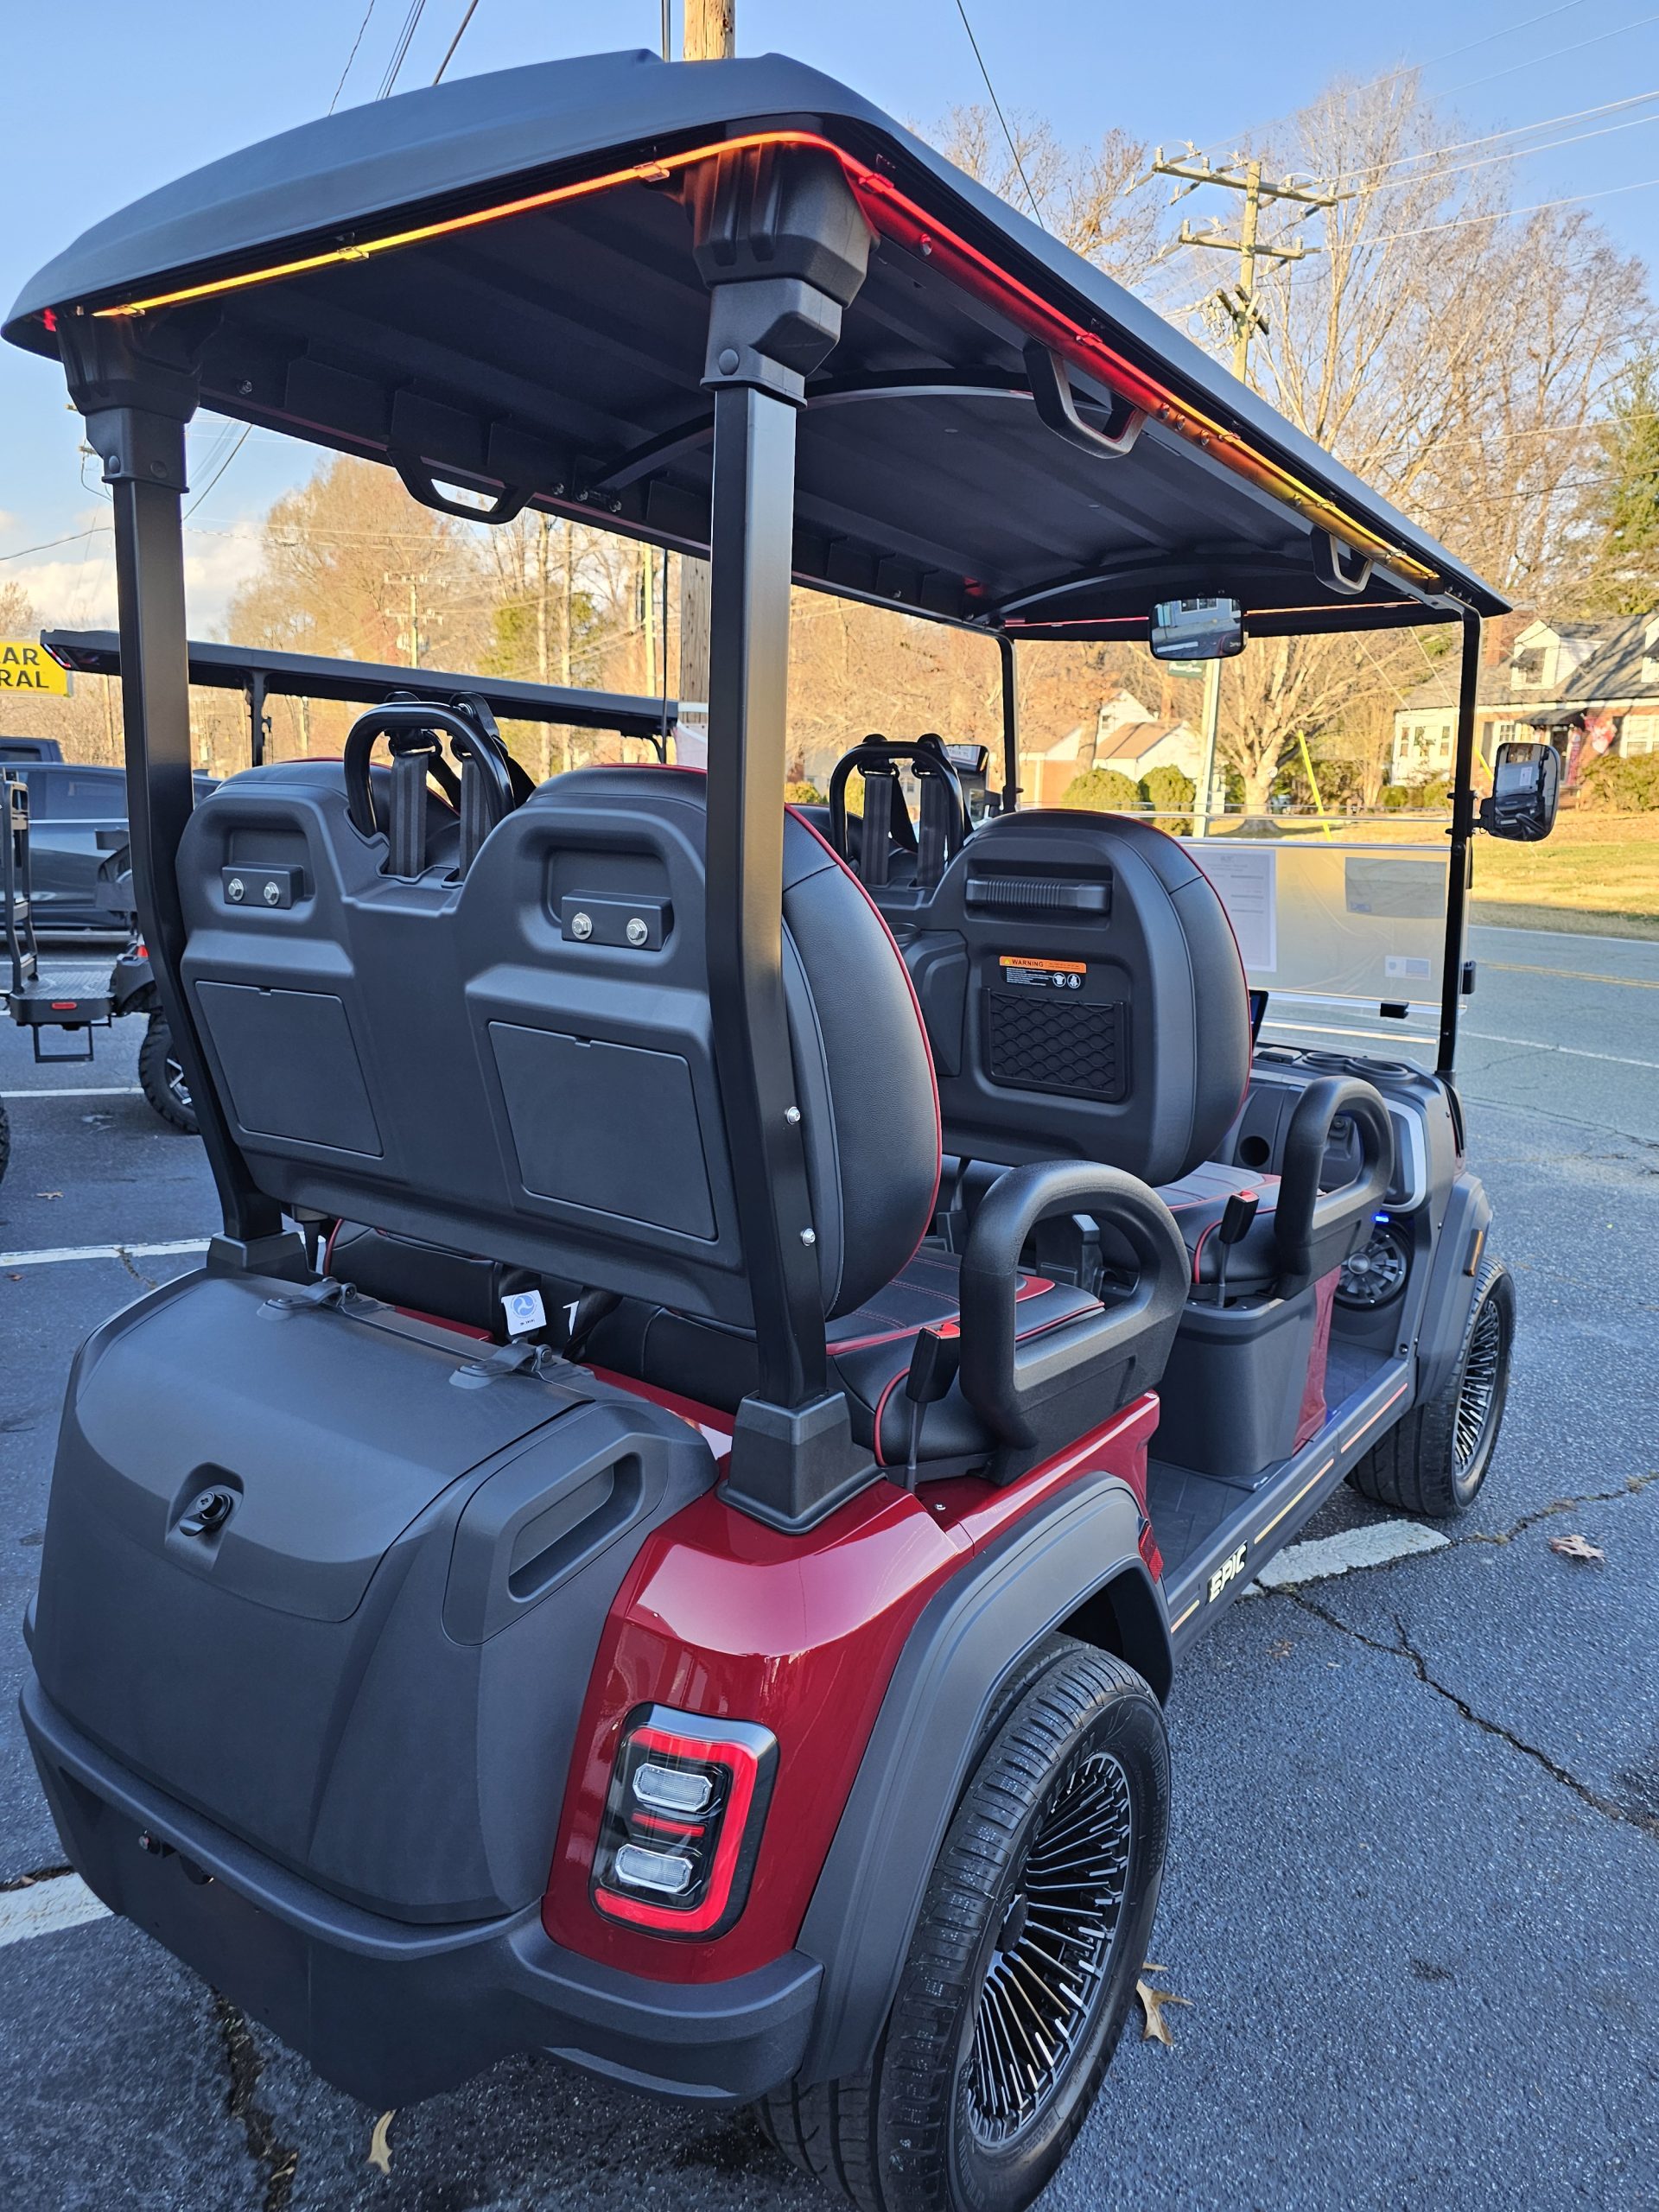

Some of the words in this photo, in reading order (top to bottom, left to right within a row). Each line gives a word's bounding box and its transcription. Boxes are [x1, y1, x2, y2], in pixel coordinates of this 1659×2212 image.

[0, 669, 49, 689] RAL
[1012, 958, 1044, 968] WARNING
[1210, 1544, 1246, 1603] EPIC
